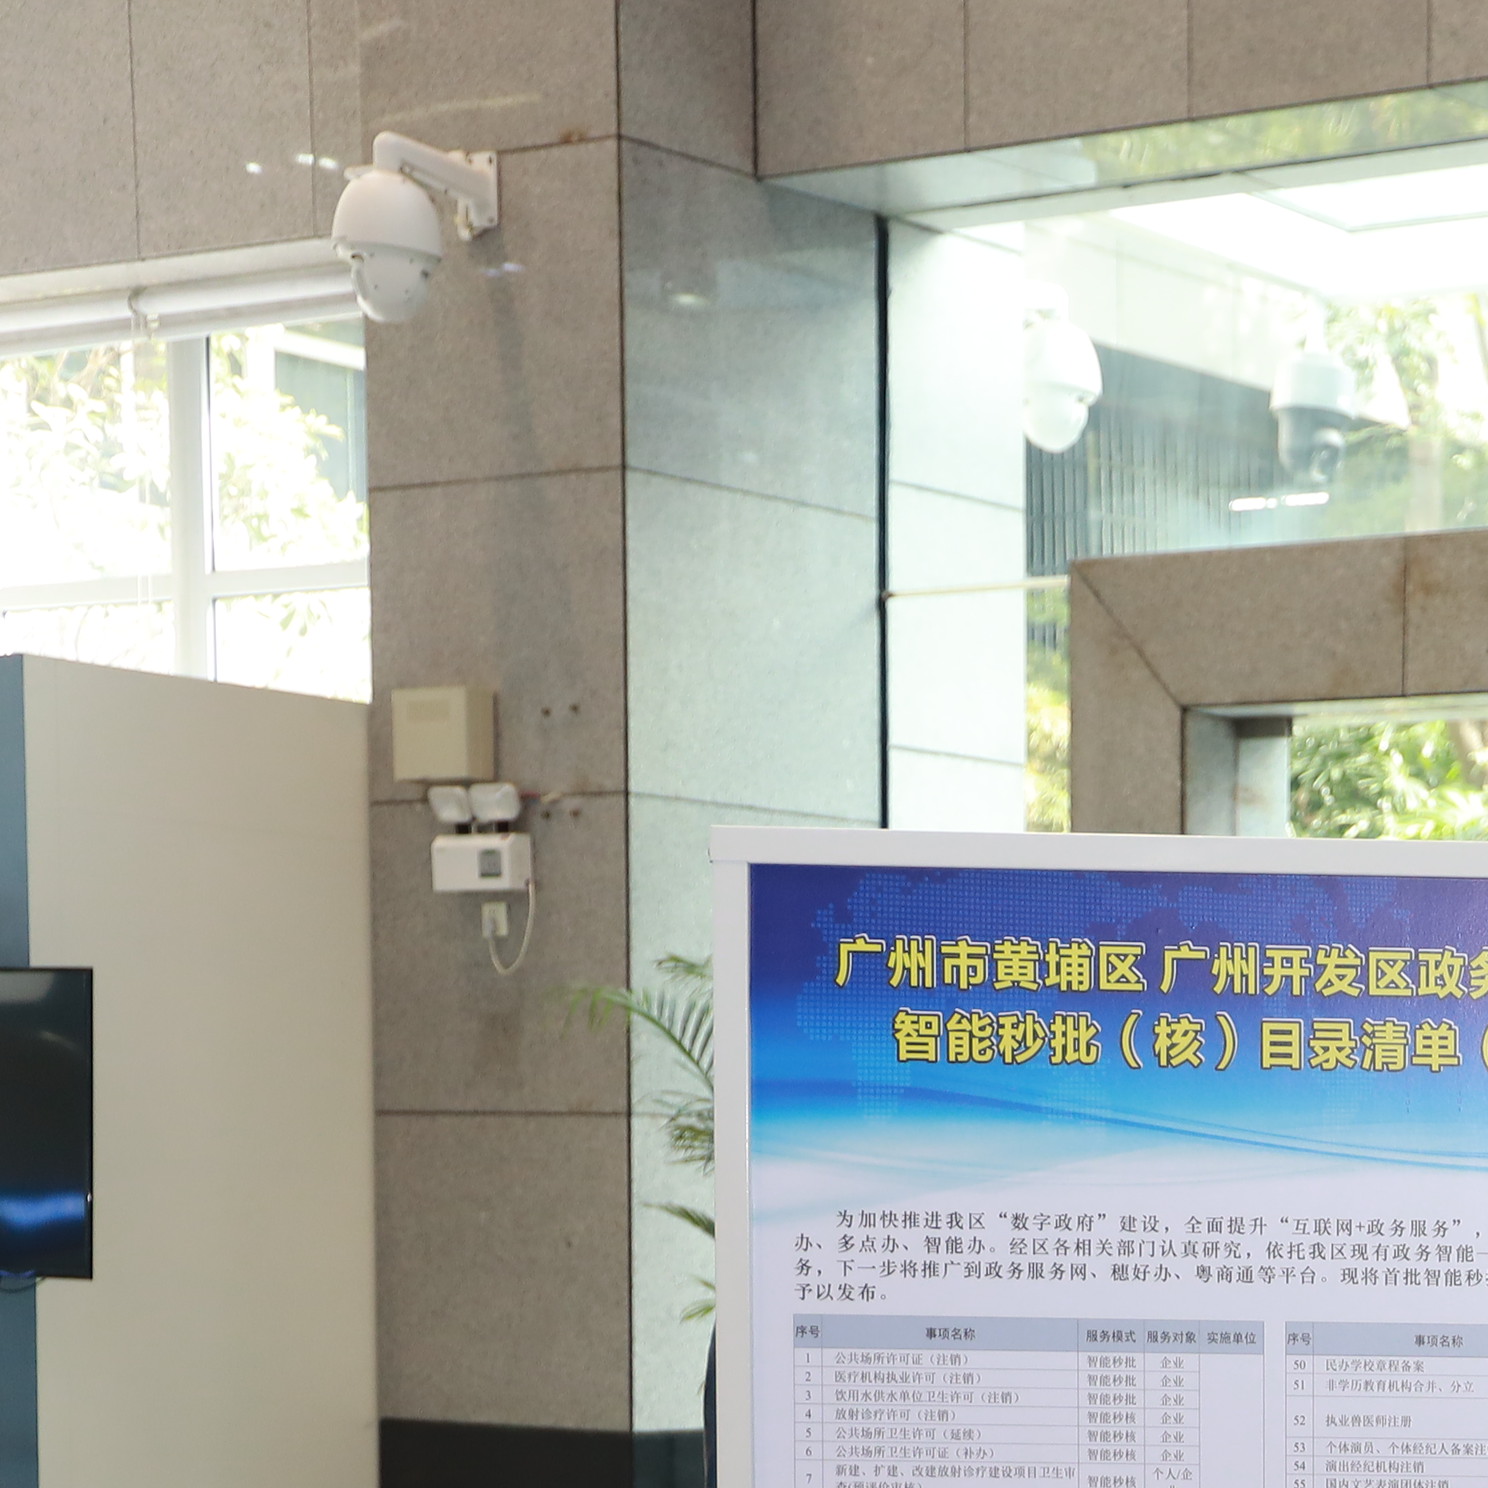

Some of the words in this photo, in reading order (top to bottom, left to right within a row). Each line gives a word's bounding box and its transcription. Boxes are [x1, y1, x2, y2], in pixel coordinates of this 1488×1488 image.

[835, 936, 1146, 992] 广州市黄埔区
[794, 1283, 890, 1302] 予以发布。
[795, 1324, 819, 1338] 序号
[925, 1327, 975, 1340] 事项名称
[1086, 1330, 1136, 1344] 服务模式
[1146, 1331, 1196, 1345] 服务对象
[1207, 1331, 1257, 1345] 实施单位
[1287, 1332, 1311, 1346] 序号
[1415, 1334, 1463, 1348] 事项名称
[1087, 1355, 1136, 1369] 智能秒批
[1161, 1356, 1184, 1369] 企业
[1326, 1358, 1424, 1372] 民办学校章程备案
[835, 1371, 983, 1384] 医疗机构执业许可（注销）
[835, 1408, 958, 1422] 放射诊疗许可（注销）
[1326, 1414, 1412, 1428] 执业兽医师注册
[835, 1427, 983, 1441] 公共场所卫生许可（延续）
